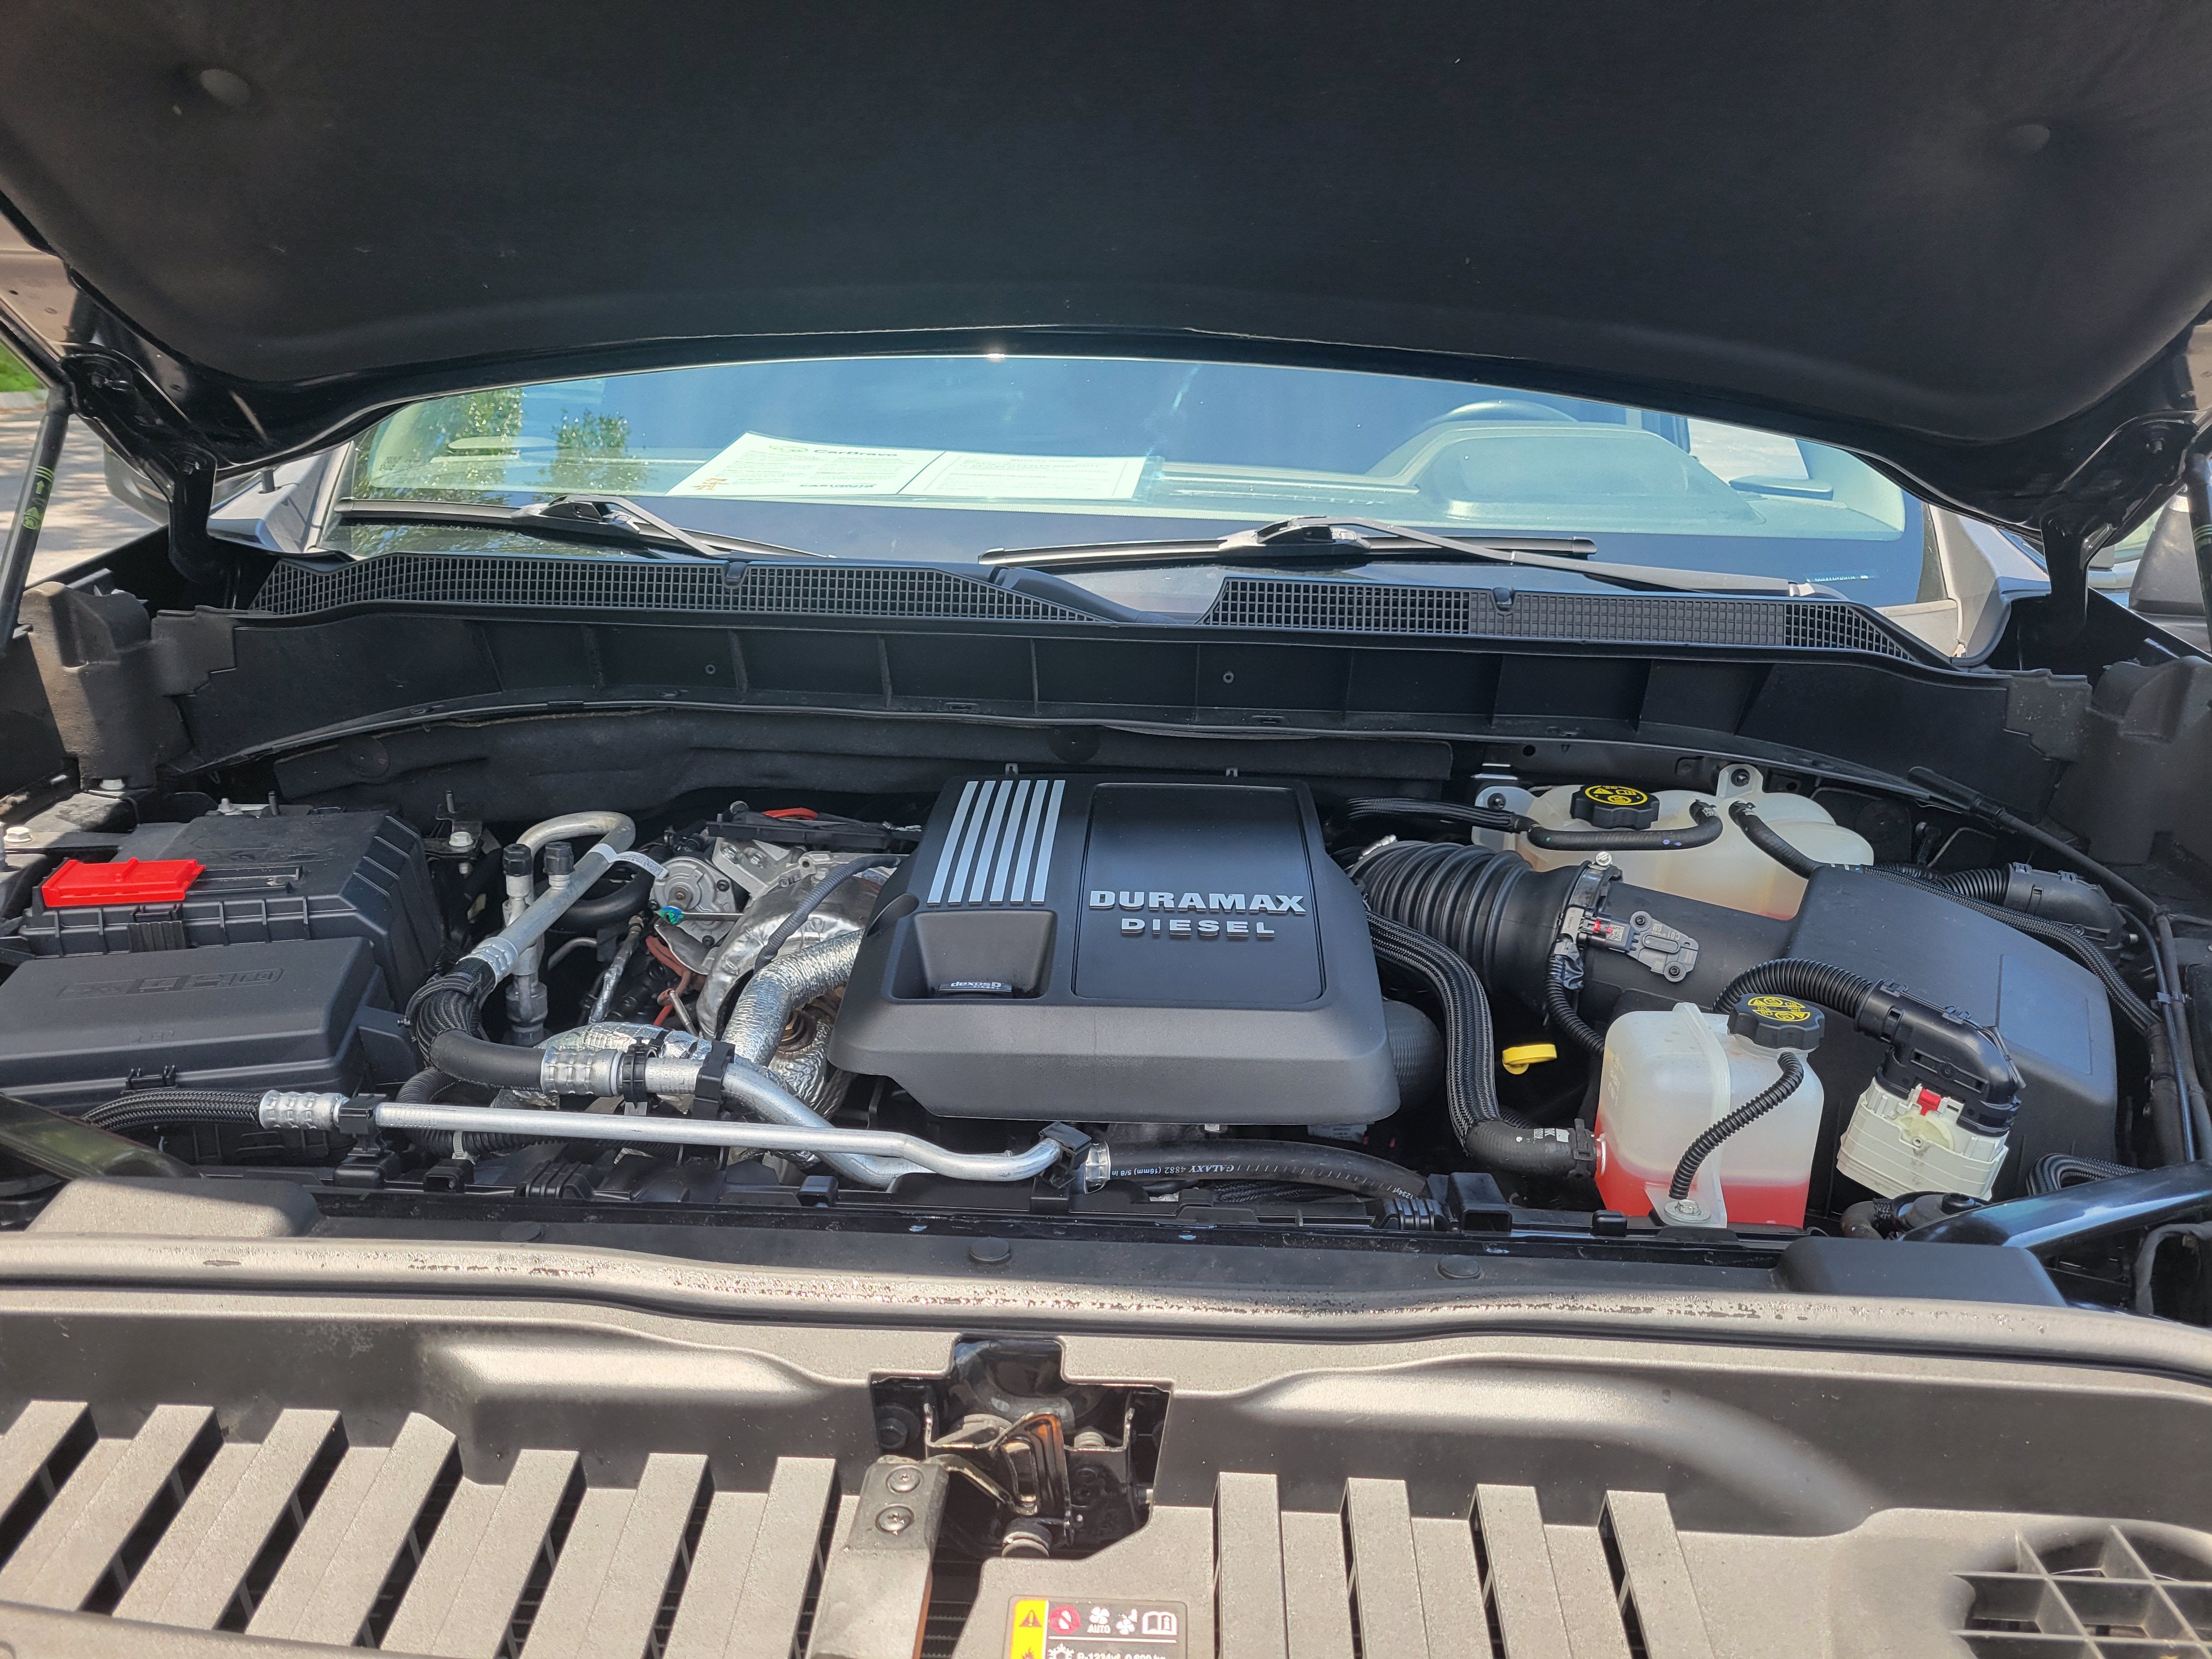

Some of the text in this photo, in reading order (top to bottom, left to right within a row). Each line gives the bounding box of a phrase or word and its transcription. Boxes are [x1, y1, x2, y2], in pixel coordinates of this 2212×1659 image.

[1089, 890, 1306, 915] DURAMAX
[1121, 918, 1275, 937] DIESEL
[1133, 1166, 1163, 1176] (16mm)
[1164, 1165, 1187, 1174] 4882
[1187, 1164, 1235, 1173] GALAXY
[1087, 1624, 1111, 1634] AUTO
